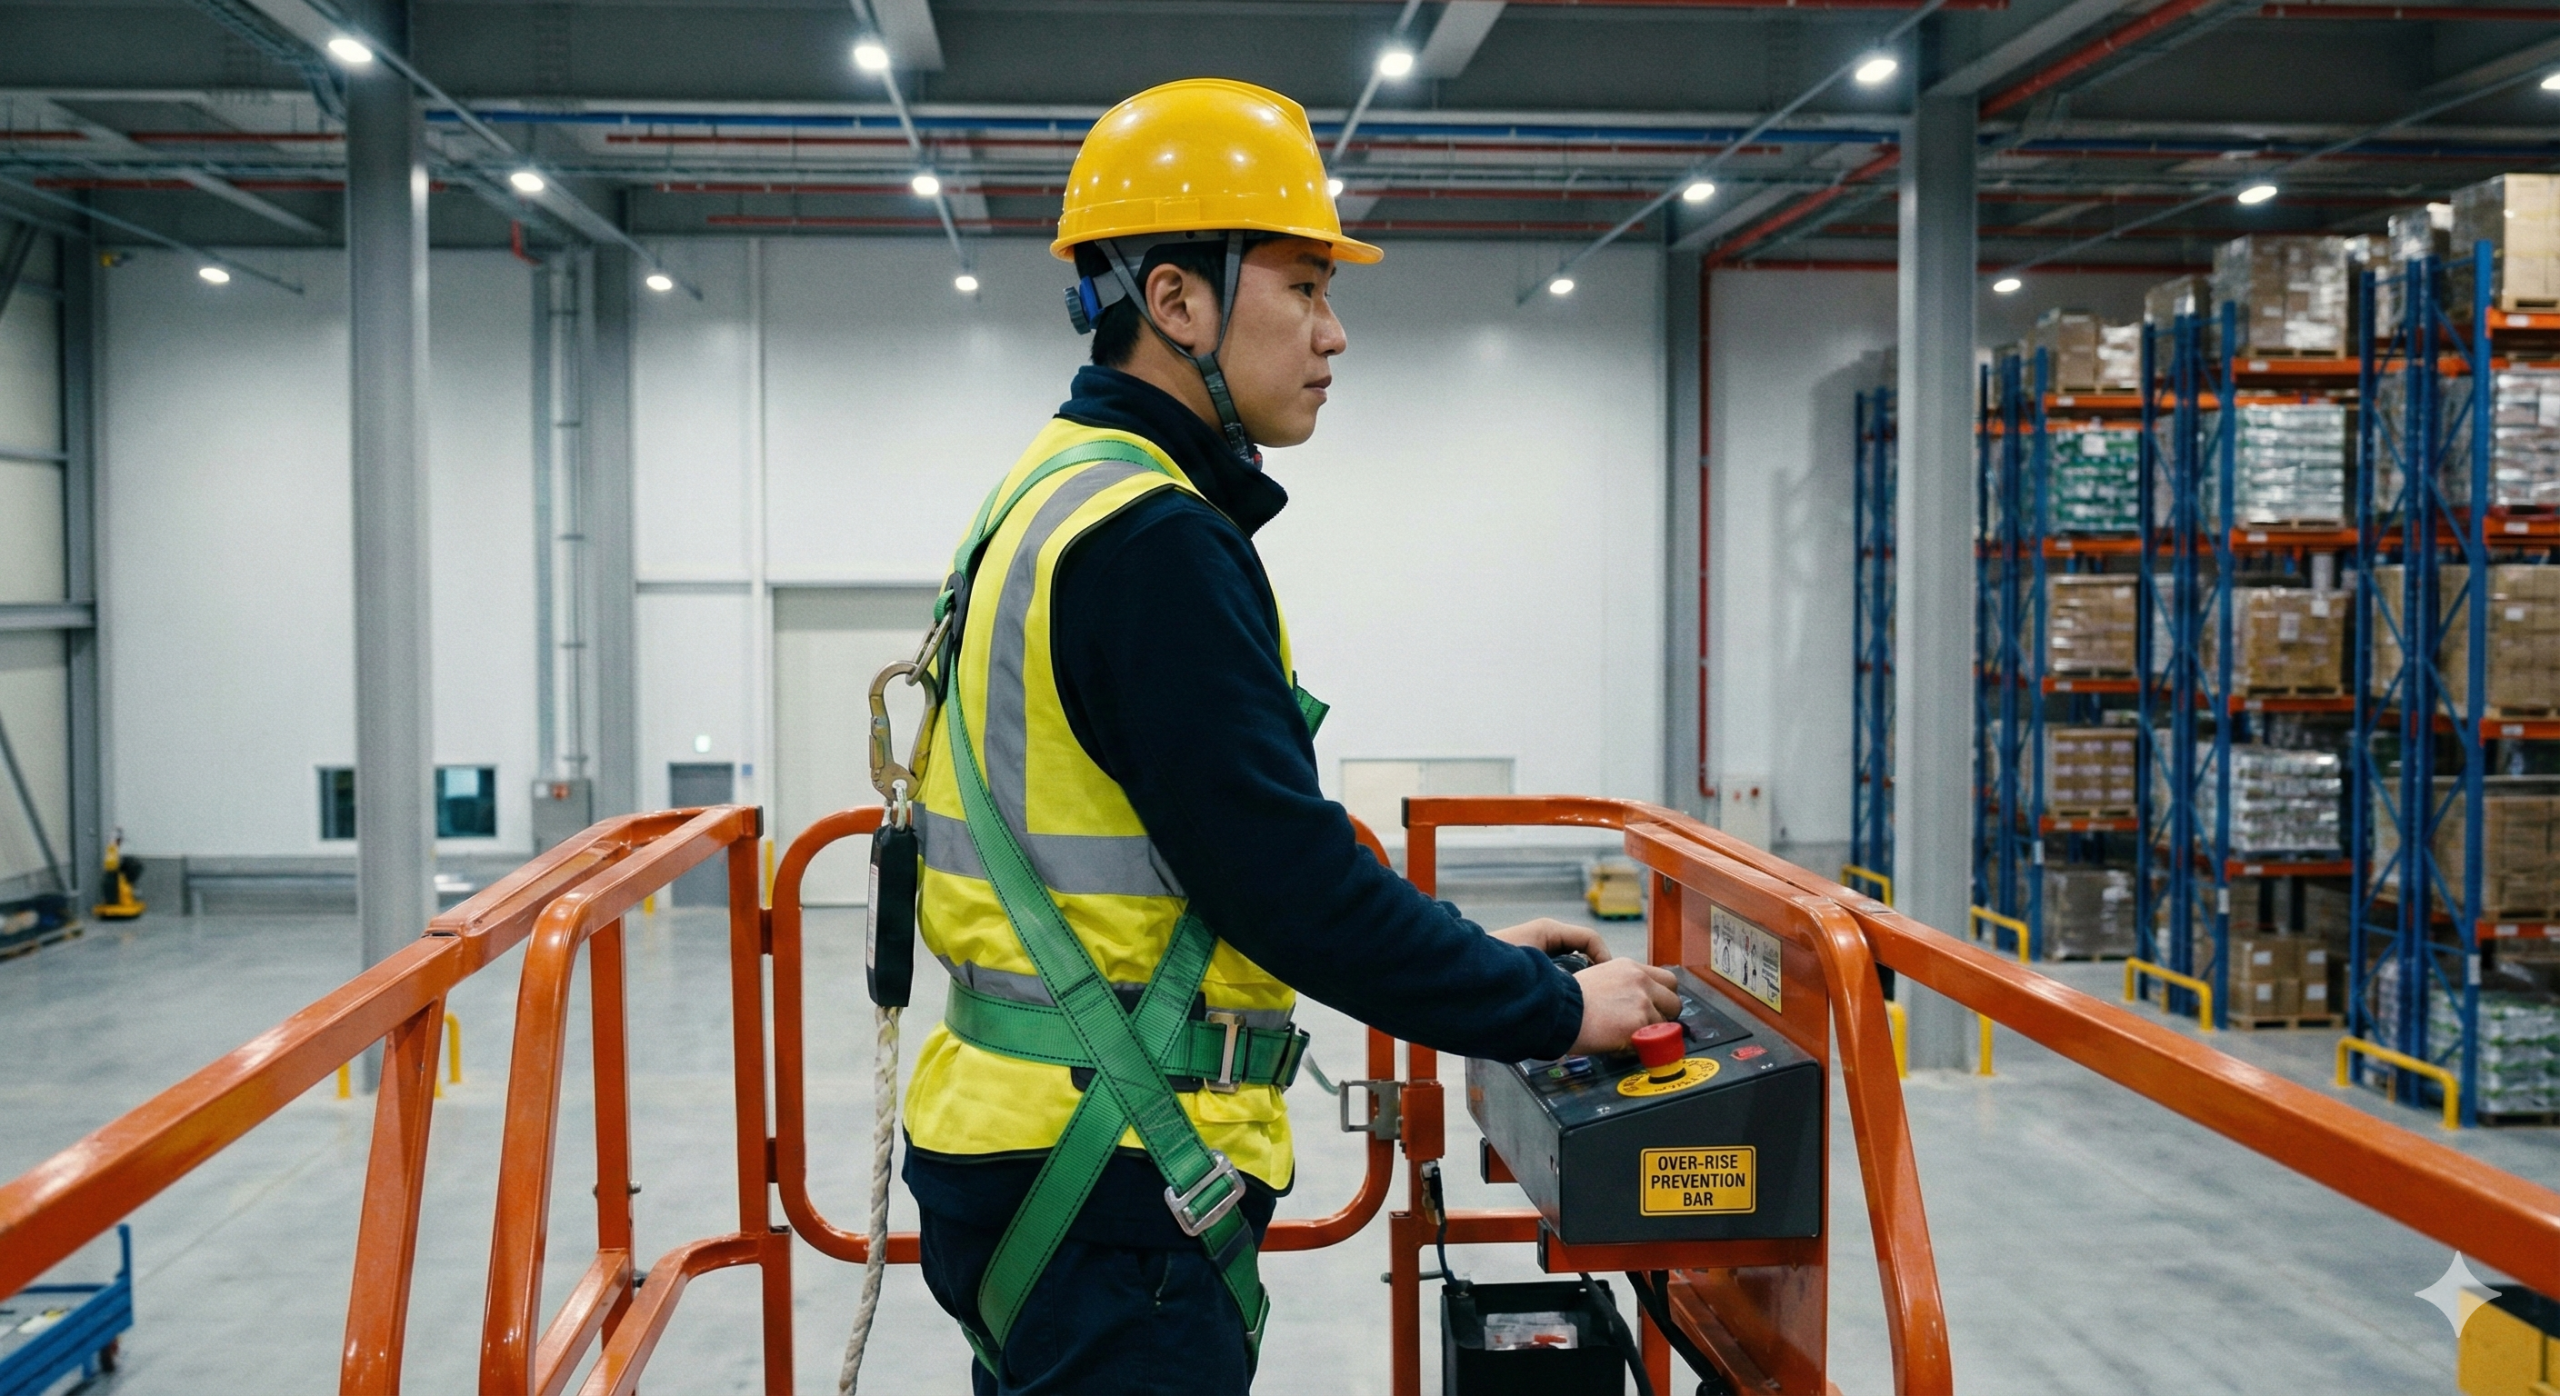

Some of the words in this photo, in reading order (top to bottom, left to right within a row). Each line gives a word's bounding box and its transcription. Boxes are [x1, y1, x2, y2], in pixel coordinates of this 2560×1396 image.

[1658, 1154, 1738, 1171] OVER-RISE
[1651, 1173, 1746, 1189] PREVENTION
[1683, 1191, 1714, 1207] BAR
